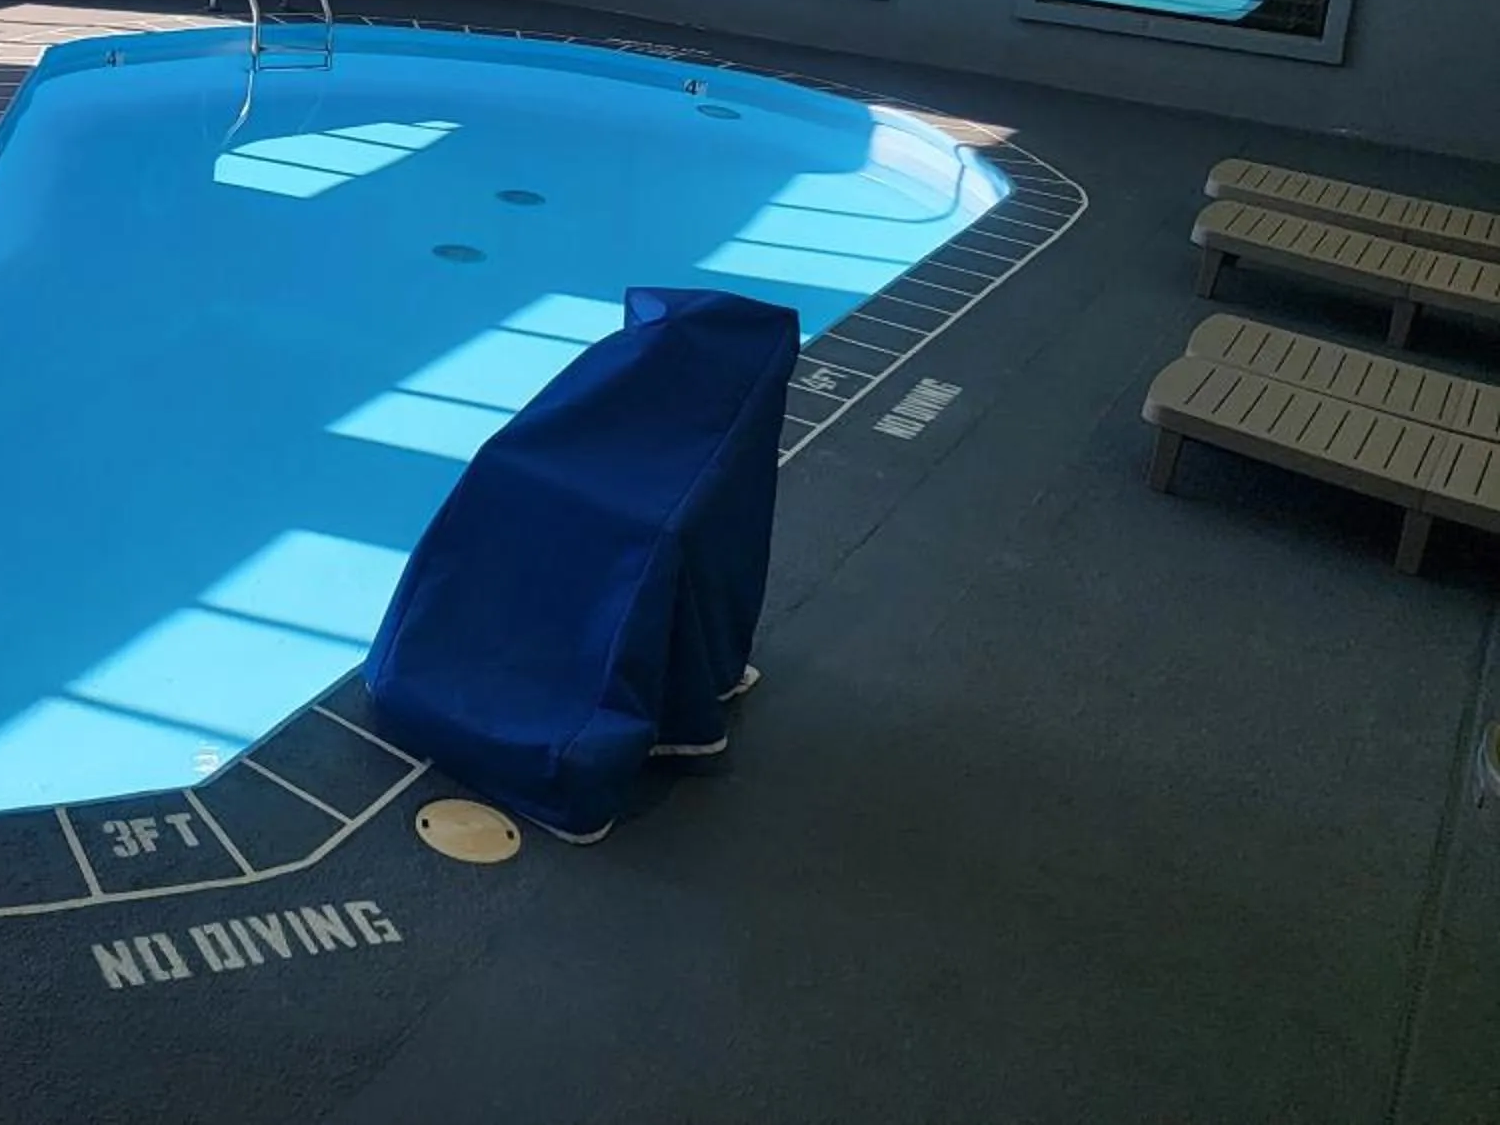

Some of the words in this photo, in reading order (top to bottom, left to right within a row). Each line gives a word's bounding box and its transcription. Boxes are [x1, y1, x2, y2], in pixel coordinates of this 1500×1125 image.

[891, 378, 963, 422] DIVING
[873, 413, 926, 440] NO
[103, 813, 200, 857] 3FT
[91, 932, 193, 989] NO
[189, 900, 403, 972] DIVING
